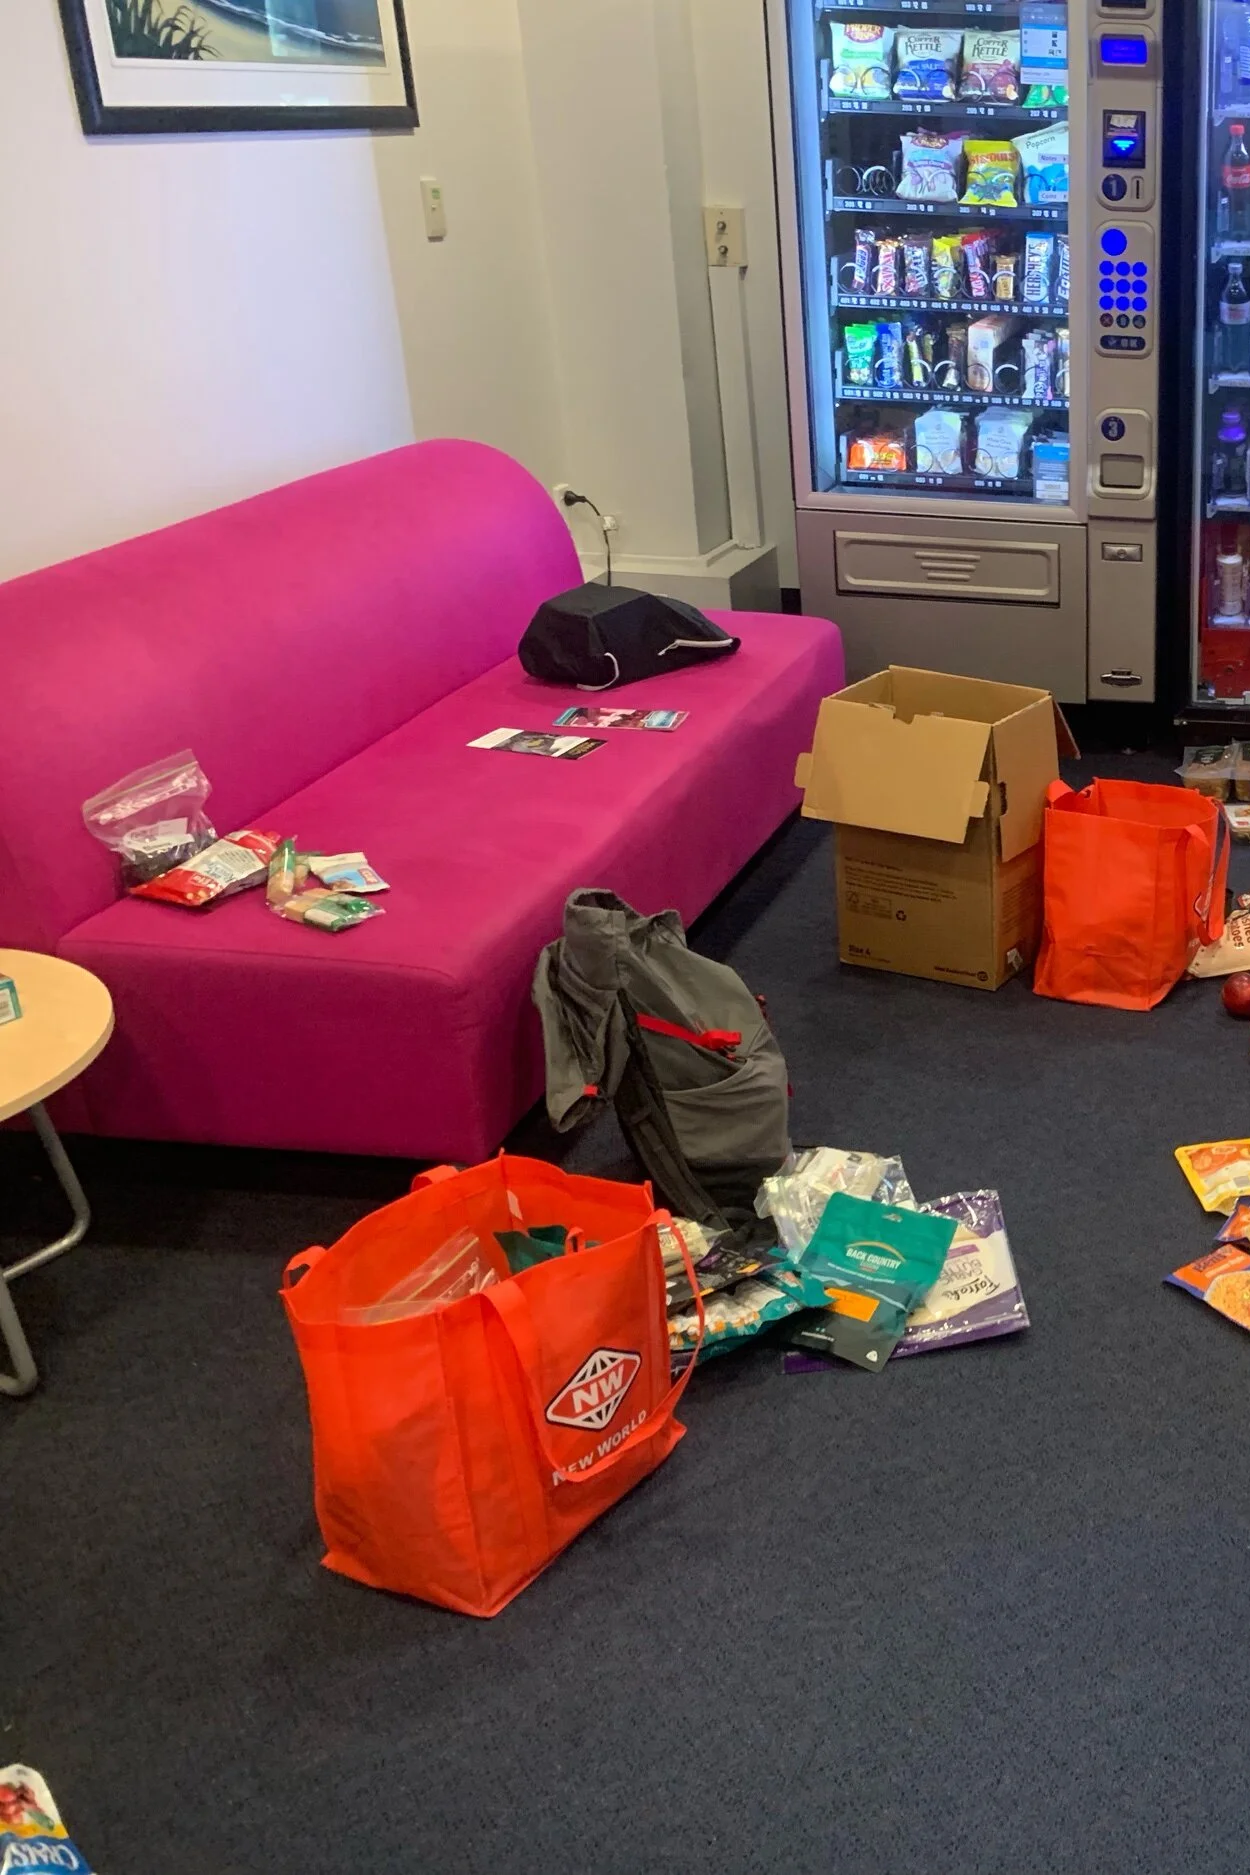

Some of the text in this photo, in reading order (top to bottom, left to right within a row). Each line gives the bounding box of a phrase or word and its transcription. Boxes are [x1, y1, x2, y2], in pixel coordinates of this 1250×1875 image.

[905, 41, 942, 55] KETTLE
[972, 44, 1009, 57] KETTLE
[1026, 135, 1056, 149] Popcorn
[845, 1247, 902, 1270] BACK COUNTRY
[572, 1363, 625, 1414] NW
[551, 1408, 648, 1487] NEW WORLD
